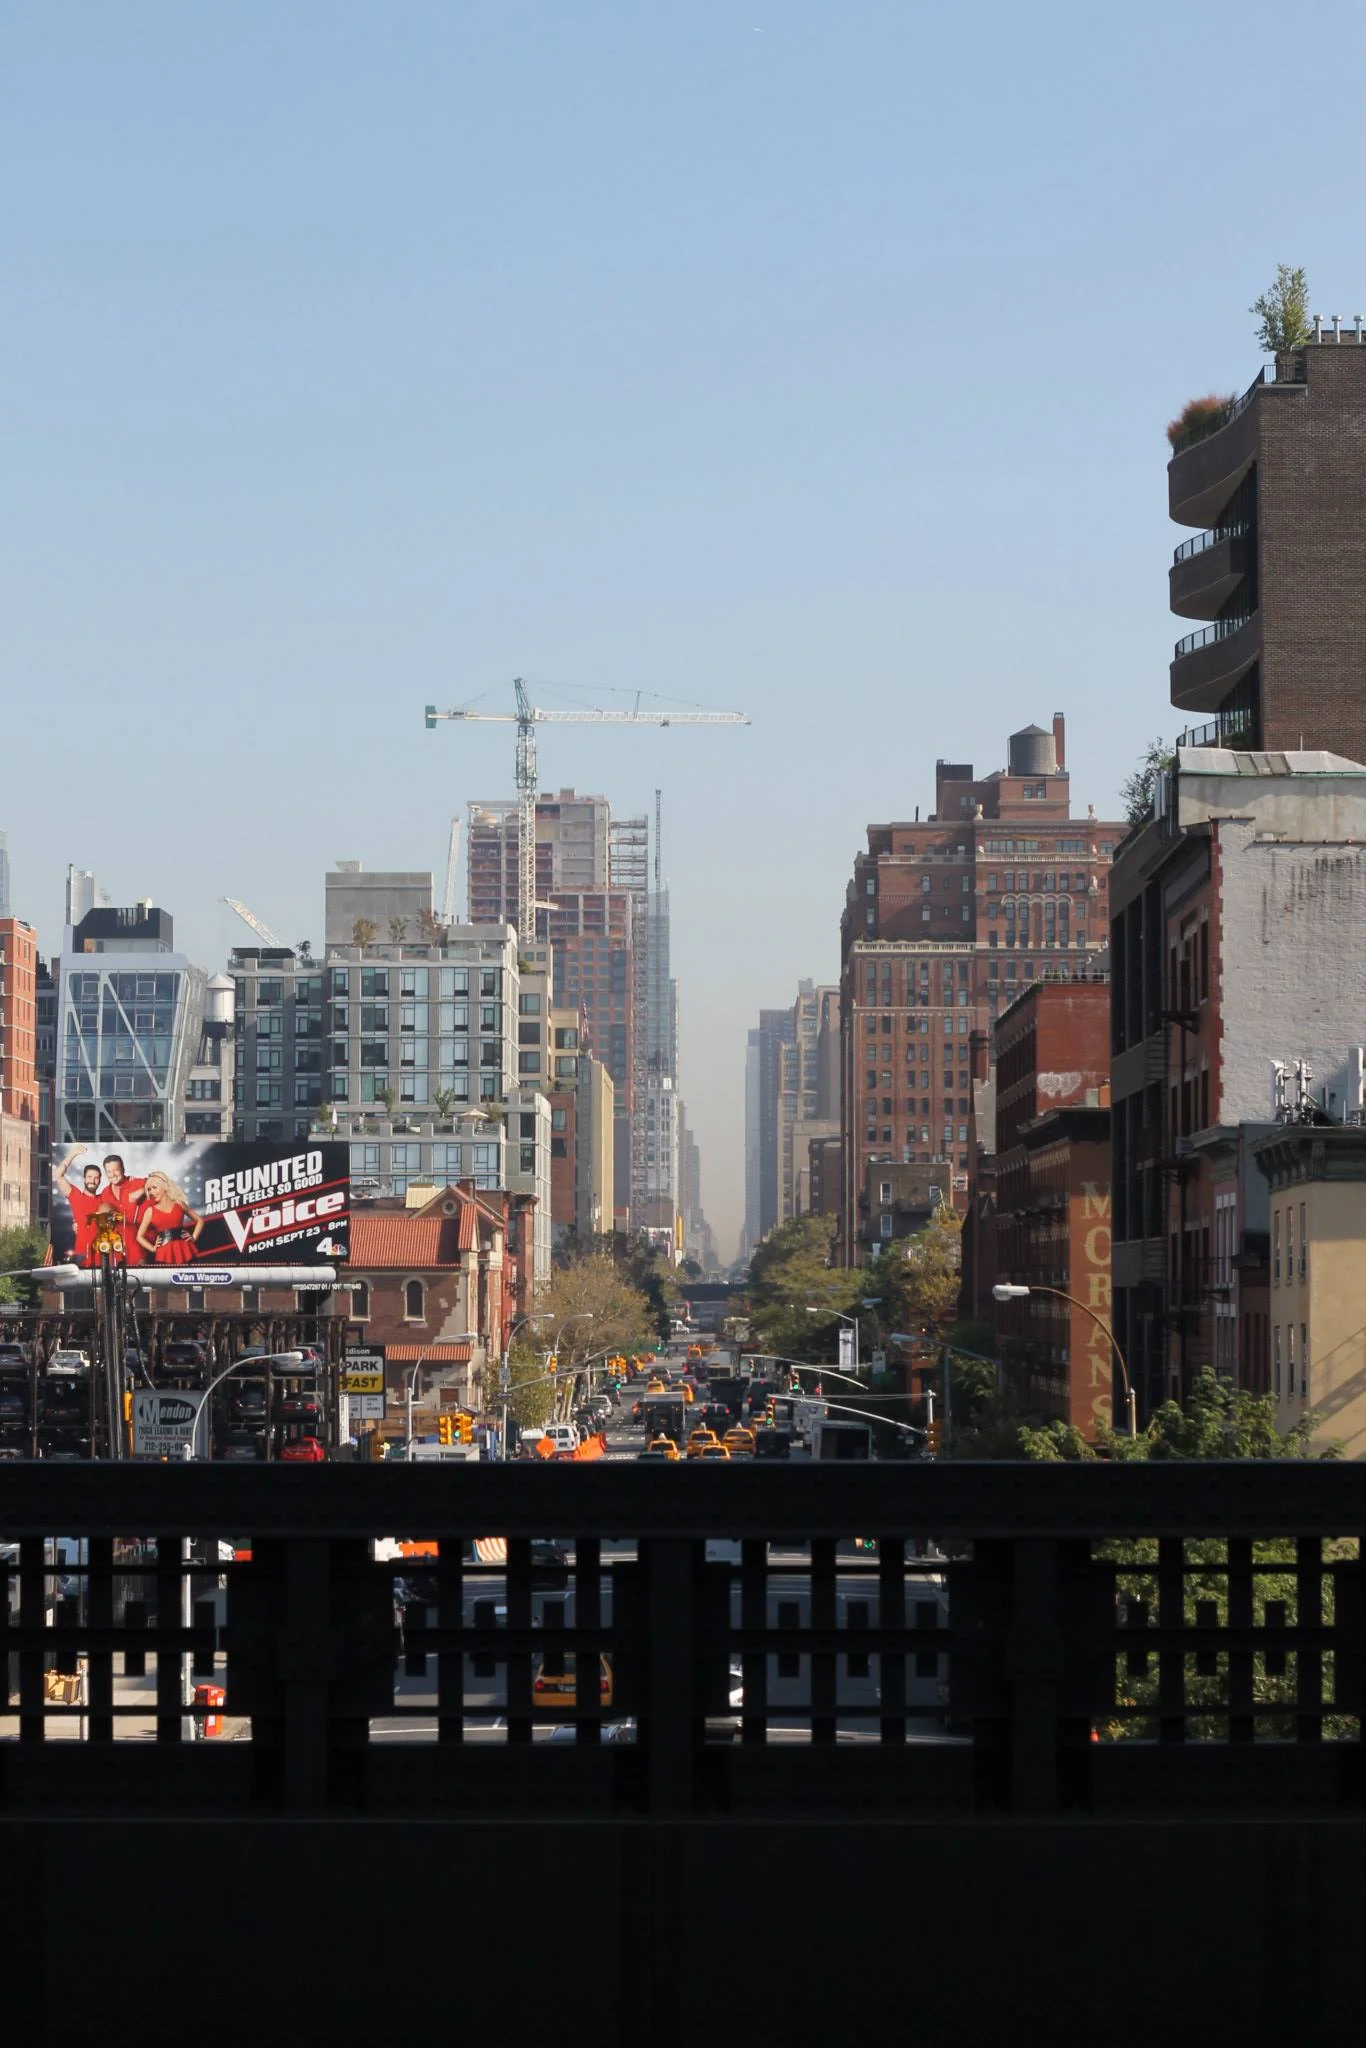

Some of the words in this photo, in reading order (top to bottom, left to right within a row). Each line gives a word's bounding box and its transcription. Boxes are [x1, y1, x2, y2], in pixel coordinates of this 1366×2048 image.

[205, 1150, 323, 1203] REUNITED
[205, 1199, 228, 1215] AND
[230, 1195, 240, 1208] IT
[243, 1186, 274, 1204] FEELS
[277, 1182, 291, 1195] SO
[294, 1173, 323, 1190] GOOD
[222, 1191, 345, 1253] Voice
[251, 1206, 271, 1217] the
[248, 1239, 274, 1253] MON
[276, 1230, 305, 1245] SEPT
[306, 1226, 321, 1237] 23
[328, 1220, 348, 1231] 8PM
[316, 1237, 334, 1255] 4
[178, 1273, 195, 1281] Van
[196, 1273, 229, 1283] Wagner
[344, 1361, 378, 1371] PARK
[142, 1398, 192, 1424] Mendon
